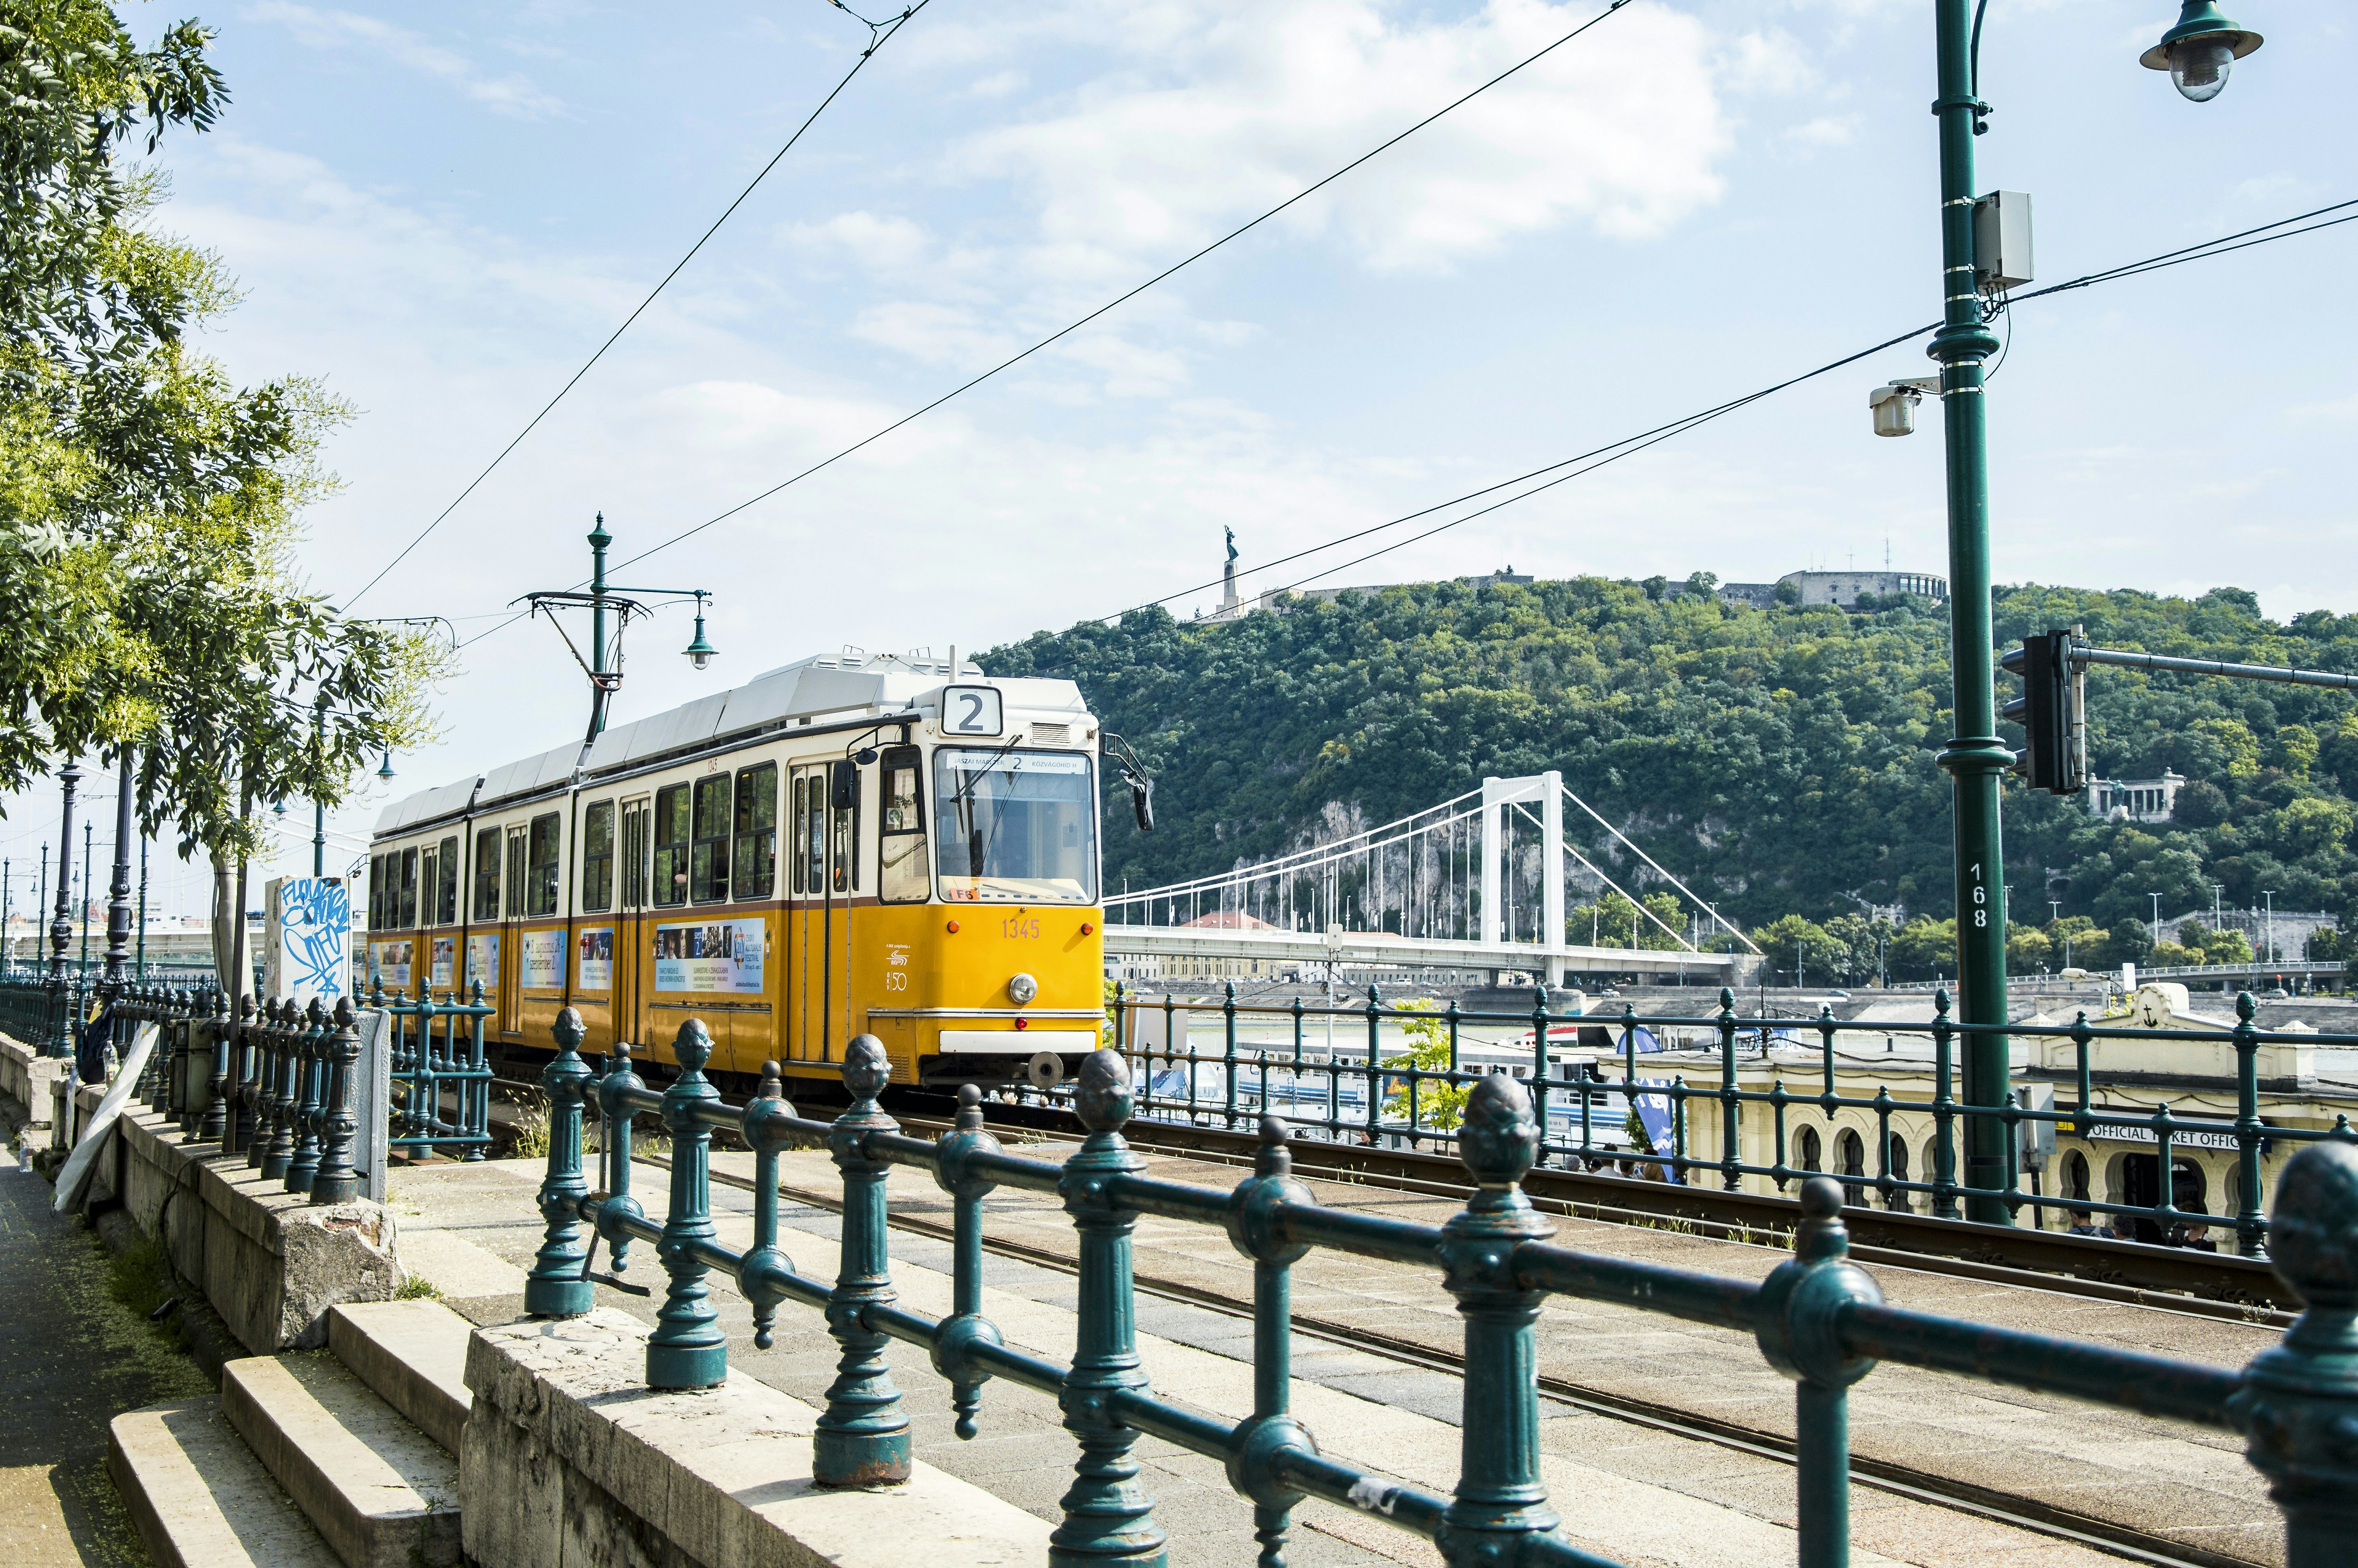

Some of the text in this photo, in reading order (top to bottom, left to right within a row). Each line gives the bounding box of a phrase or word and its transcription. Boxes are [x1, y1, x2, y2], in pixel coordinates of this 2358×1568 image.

[959, 694, 983, 731] 2
[708, 758, 717, 773] 1345
[1013, 757, 1022, 769] 2
[956, 890, 973, 899] F6
[1970, 863, 1986, 927] 168
[1003, 919, 1039, 938] 1345
[892, 972, 907, 991] 50
[2093, 1125, 2239, 1148] OFFICIAL TKET OFFIC
